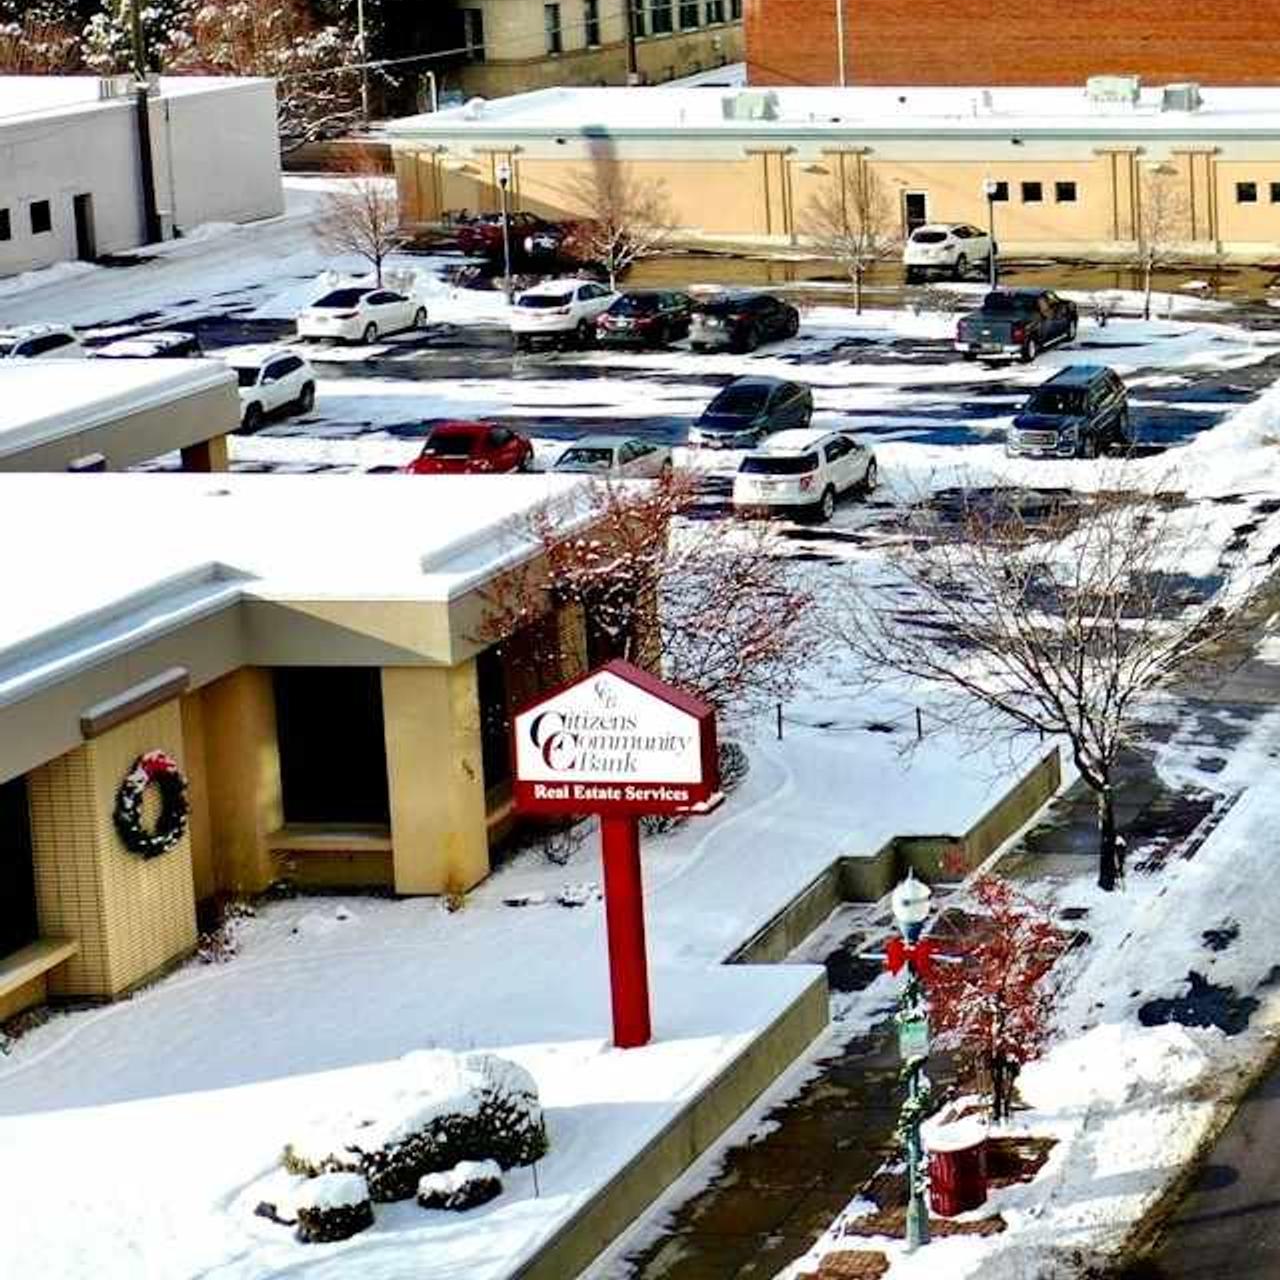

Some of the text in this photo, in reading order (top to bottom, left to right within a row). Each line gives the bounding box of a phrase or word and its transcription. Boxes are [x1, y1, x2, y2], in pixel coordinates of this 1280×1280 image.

[530, 710, 638, 749] Citizens
[542, 731, 691, 770] Community
[579, 752, 638, 773] Bank
[534, 784, 689, 801] Real Estate Services
